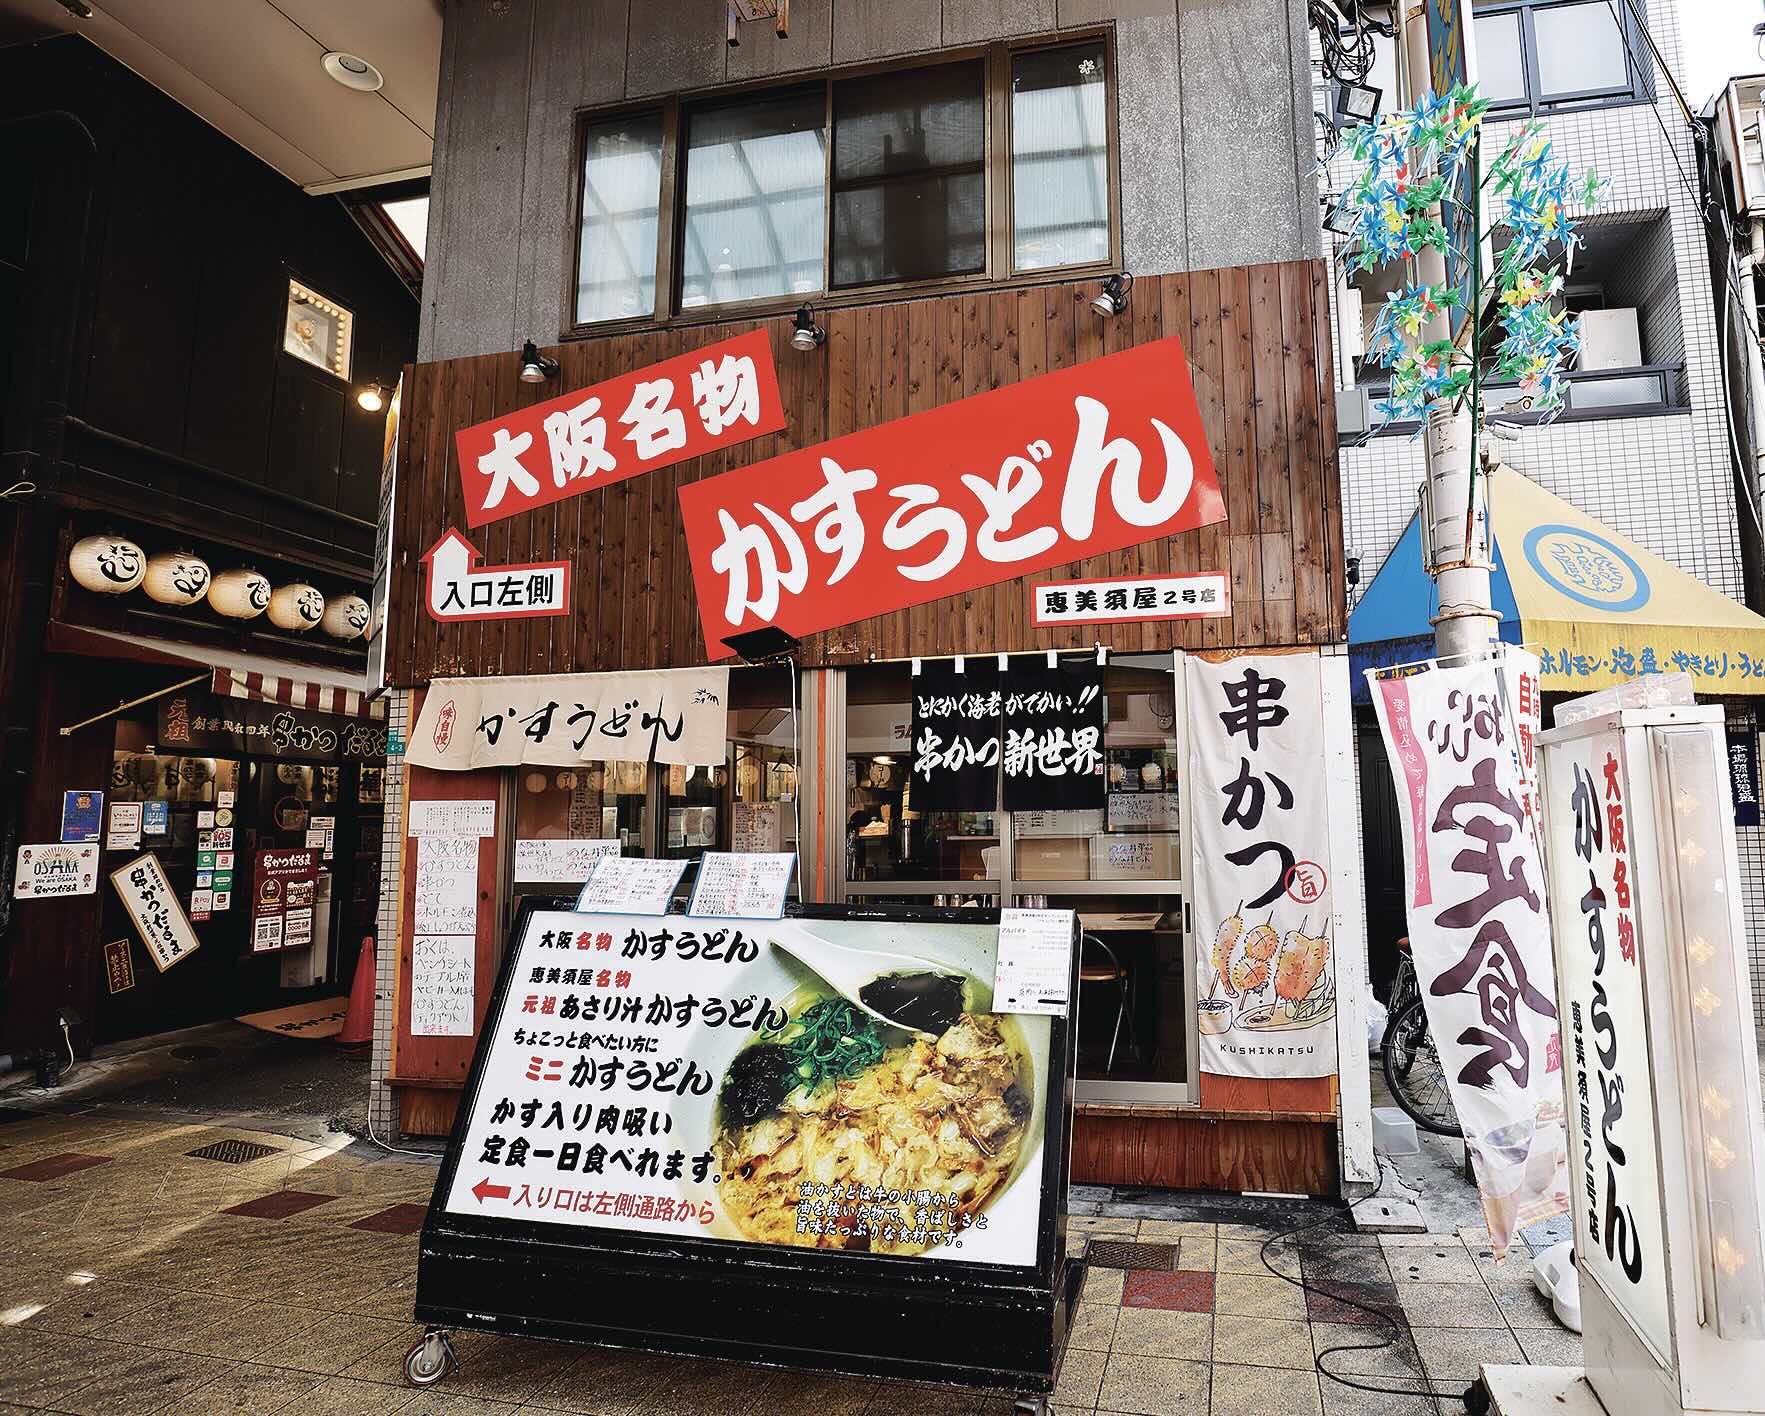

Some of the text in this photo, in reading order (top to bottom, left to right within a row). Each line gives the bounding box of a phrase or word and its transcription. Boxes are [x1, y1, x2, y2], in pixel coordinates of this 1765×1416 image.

[477, 354, 760, 511] 大阪名物
[711, 395, 1194, 626] かすうどん
[439, 573, 554, 612] 入口左側
[475, 696, 684, 763] かすうどん
[914, 725, 1103, 783] 串かつ新世界
[1219, 667, 1296, 909] 串かつ
[1603, 751, 1637, 967] 大阪名物
[538, 927, 760, 963] 大阪名物 かすうどん
[528, 967, 633, 989] 恵美須屋名物
[512, 1027, 659, 1053] ちょこっと食べたい方に
[1571, 761, 1643, 1285] かすうどん
[1220, 1043, 1315, 1056] KUSHIKATSU
[490, 1097, 673, 1137] かす入り肉吸い
[478, 1134, 722, 1185] 定食一日食べれます。
[512, 1183, 717, 1226] 入り口は左側通路から
